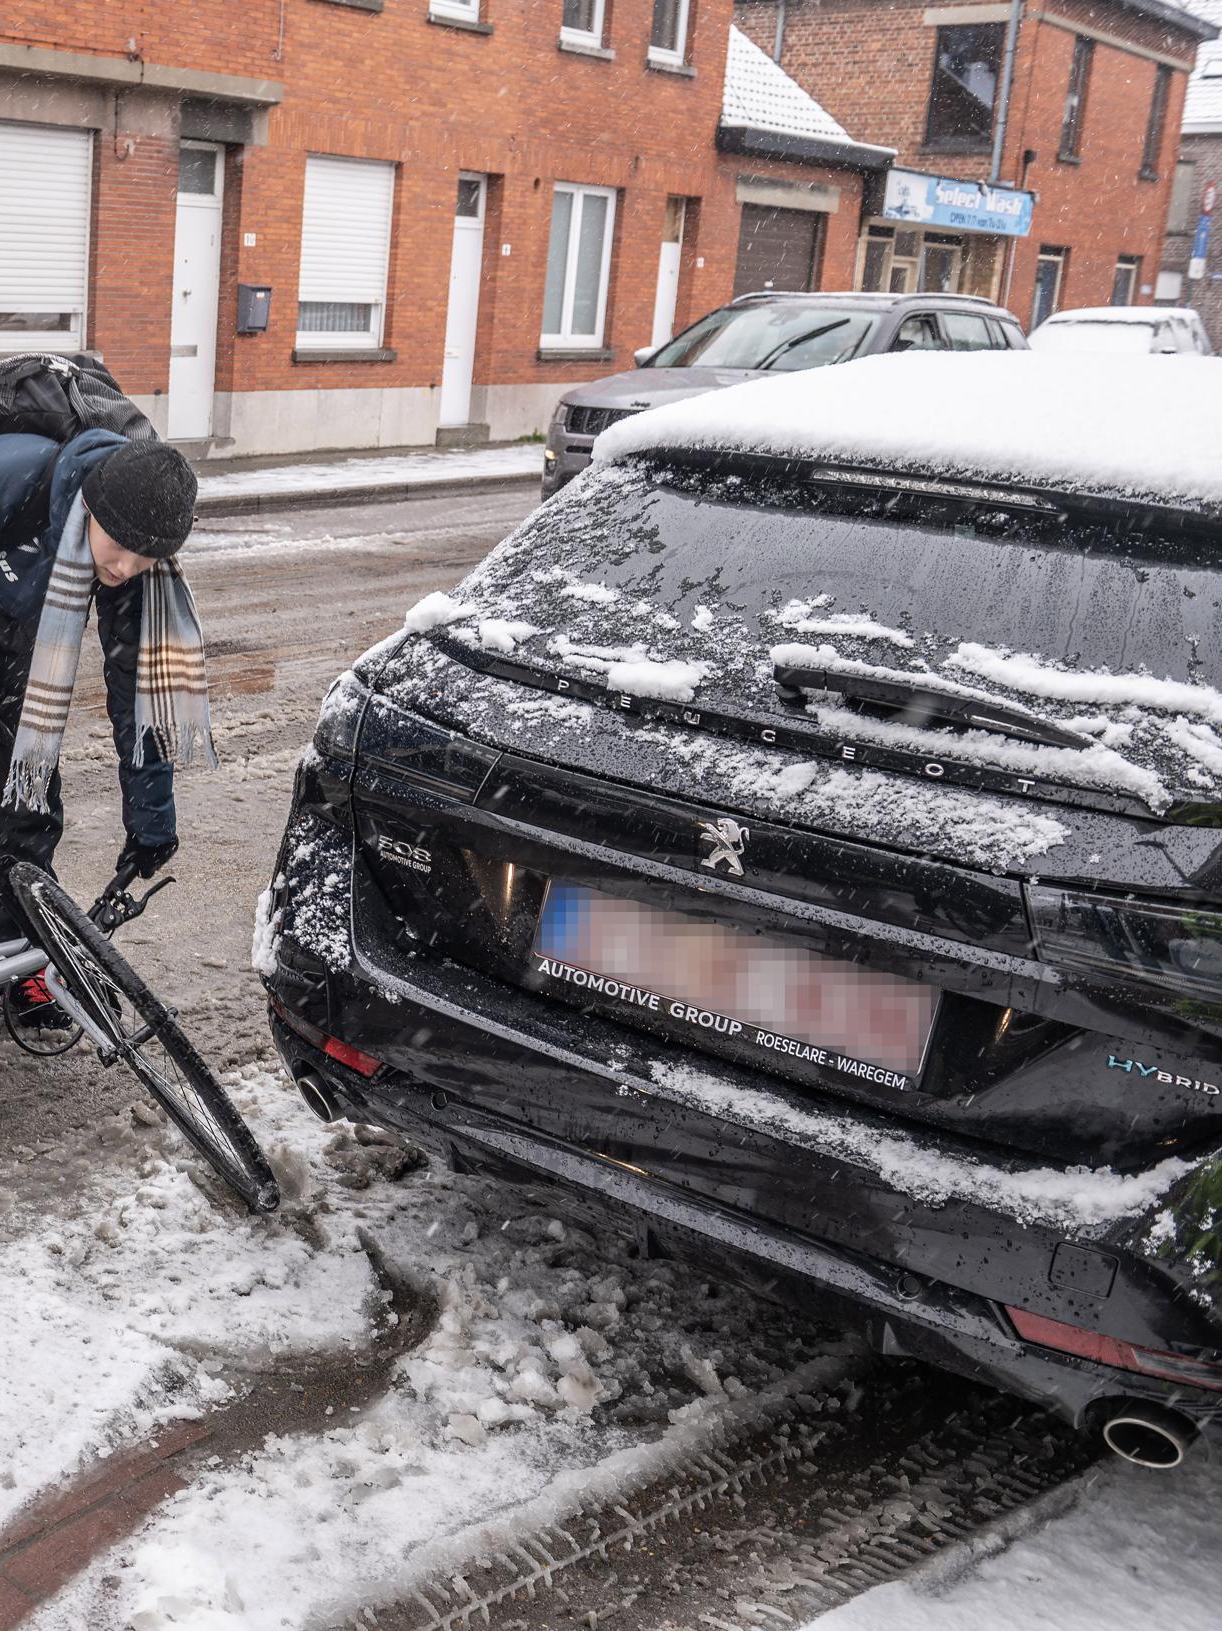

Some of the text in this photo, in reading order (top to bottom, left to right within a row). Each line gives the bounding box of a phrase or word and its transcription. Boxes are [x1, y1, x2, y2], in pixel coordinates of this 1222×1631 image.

[935, 182, 1023, 216] Select Wash
[950, 211, 966, 224] OPEN
[557, 678, 1036, 793] PEUGEOT
[380, 850, 432, 874] AUTOMOTIVE GROUP
[538, 959, 660, 1011] AUTOMOTIVE
[669, 1002, 743, 1036] GROUP
[755, 1030, 826, 1065] ROESELARE
[837, 1056, 907, 1091] WAREGEM
[1108, 1055, 1220, 1095] HYBRID
